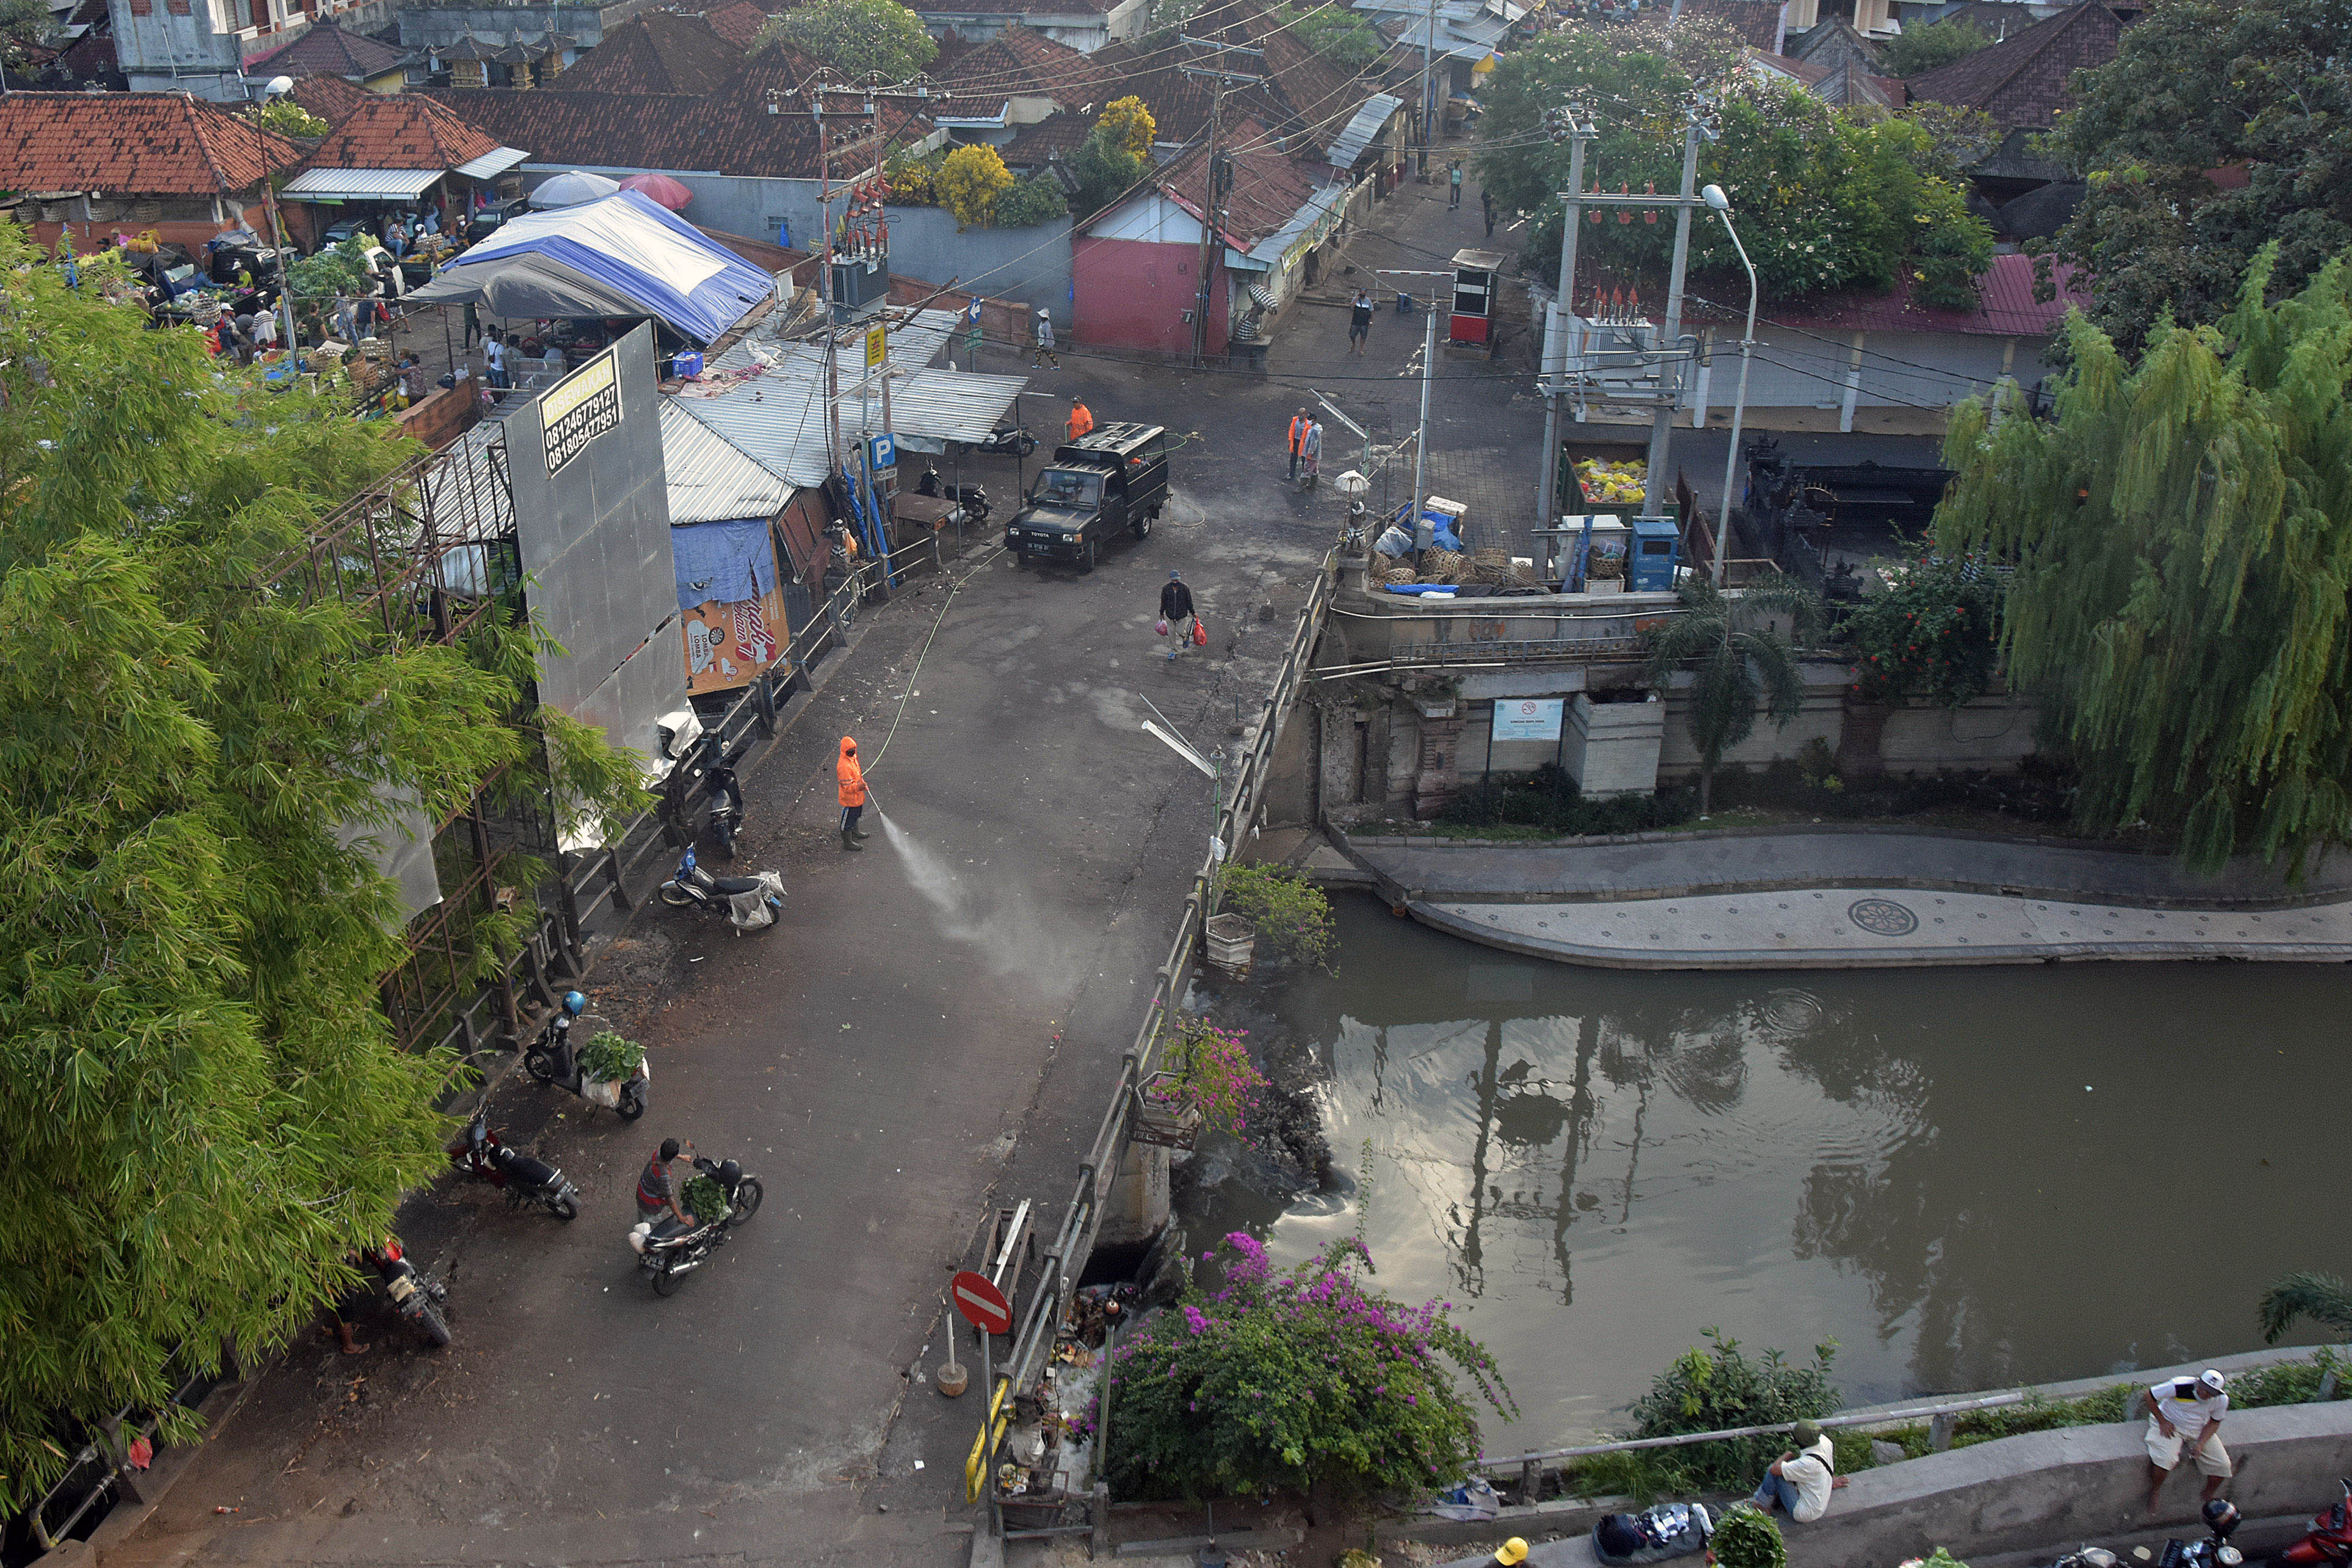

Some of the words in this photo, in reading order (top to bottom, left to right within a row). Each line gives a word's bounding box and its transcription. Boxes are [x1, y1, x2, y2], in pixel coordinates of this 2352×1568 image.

[546, 363, 611, 418] DISEWAKAN
[546, 385, 616, 449] 081246779127
[548, 405, 617, 470] 081805477951
[876, 439, 891, 464] P
